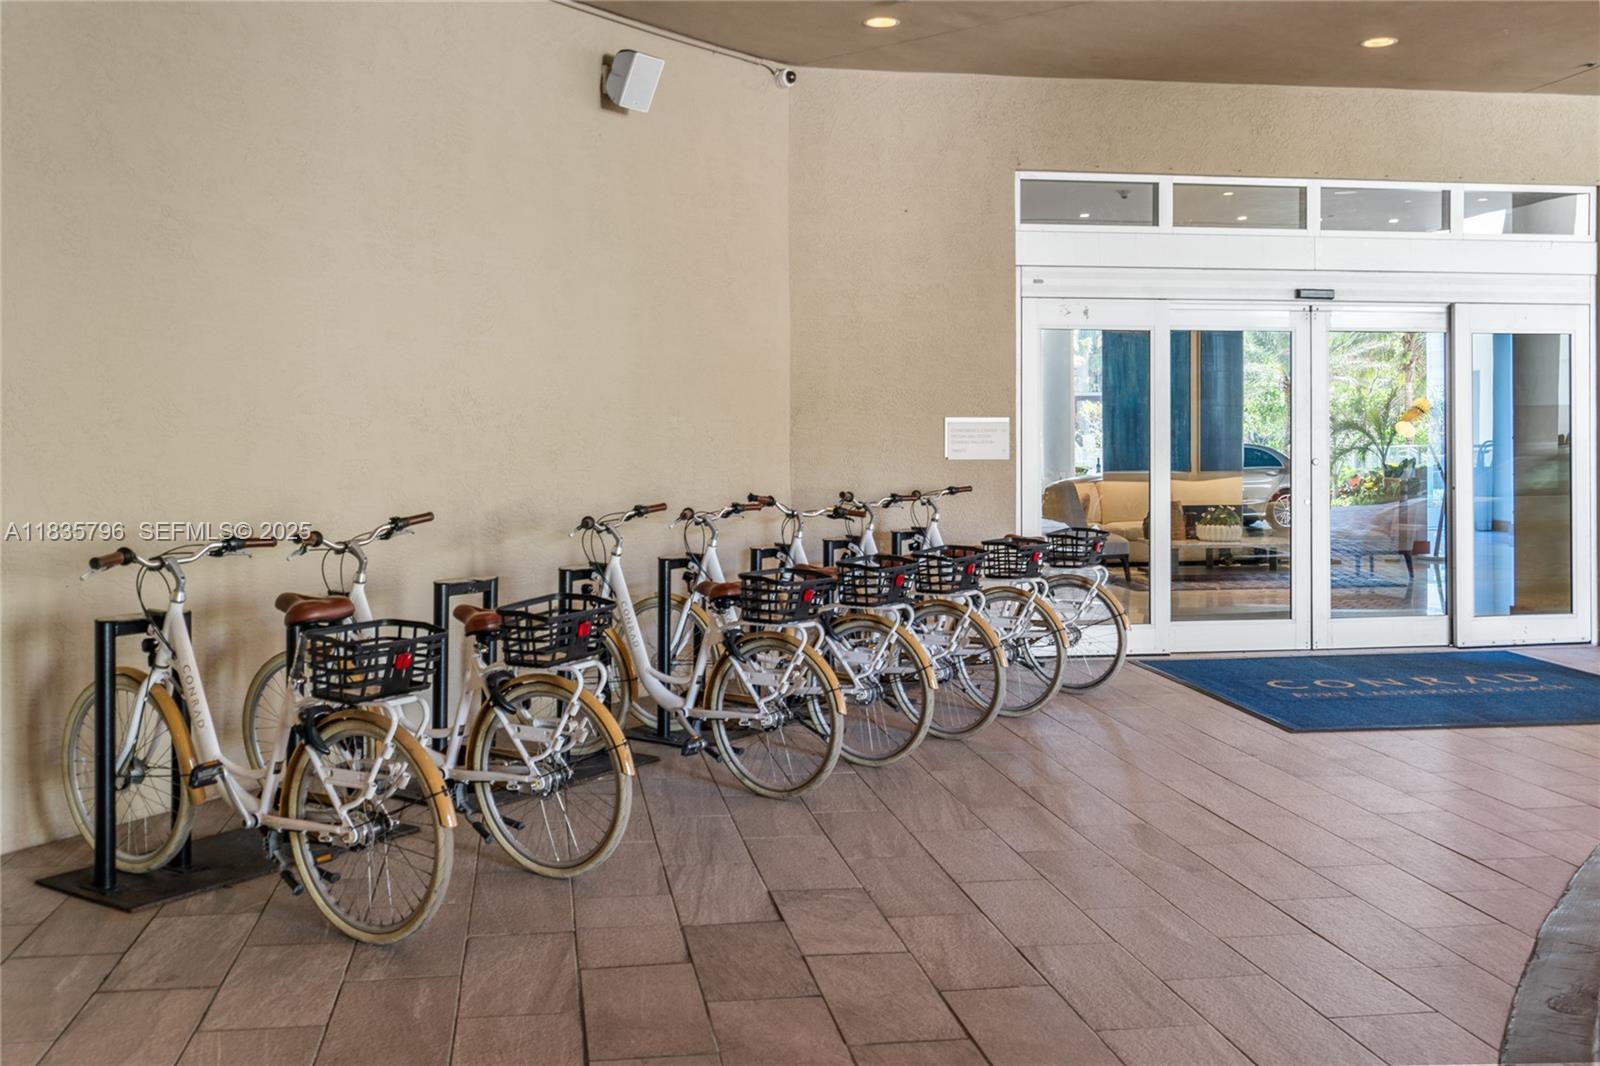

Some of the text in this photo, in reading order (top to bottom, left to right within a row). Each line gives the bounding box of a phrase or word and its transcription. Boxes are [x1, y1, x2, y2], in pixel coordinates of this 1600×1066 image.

[621, 600, 640, 648] CONRAD
[183, 664, 205, 729] CONRAD
[1266, 672, 1540, 690] CONRAD
